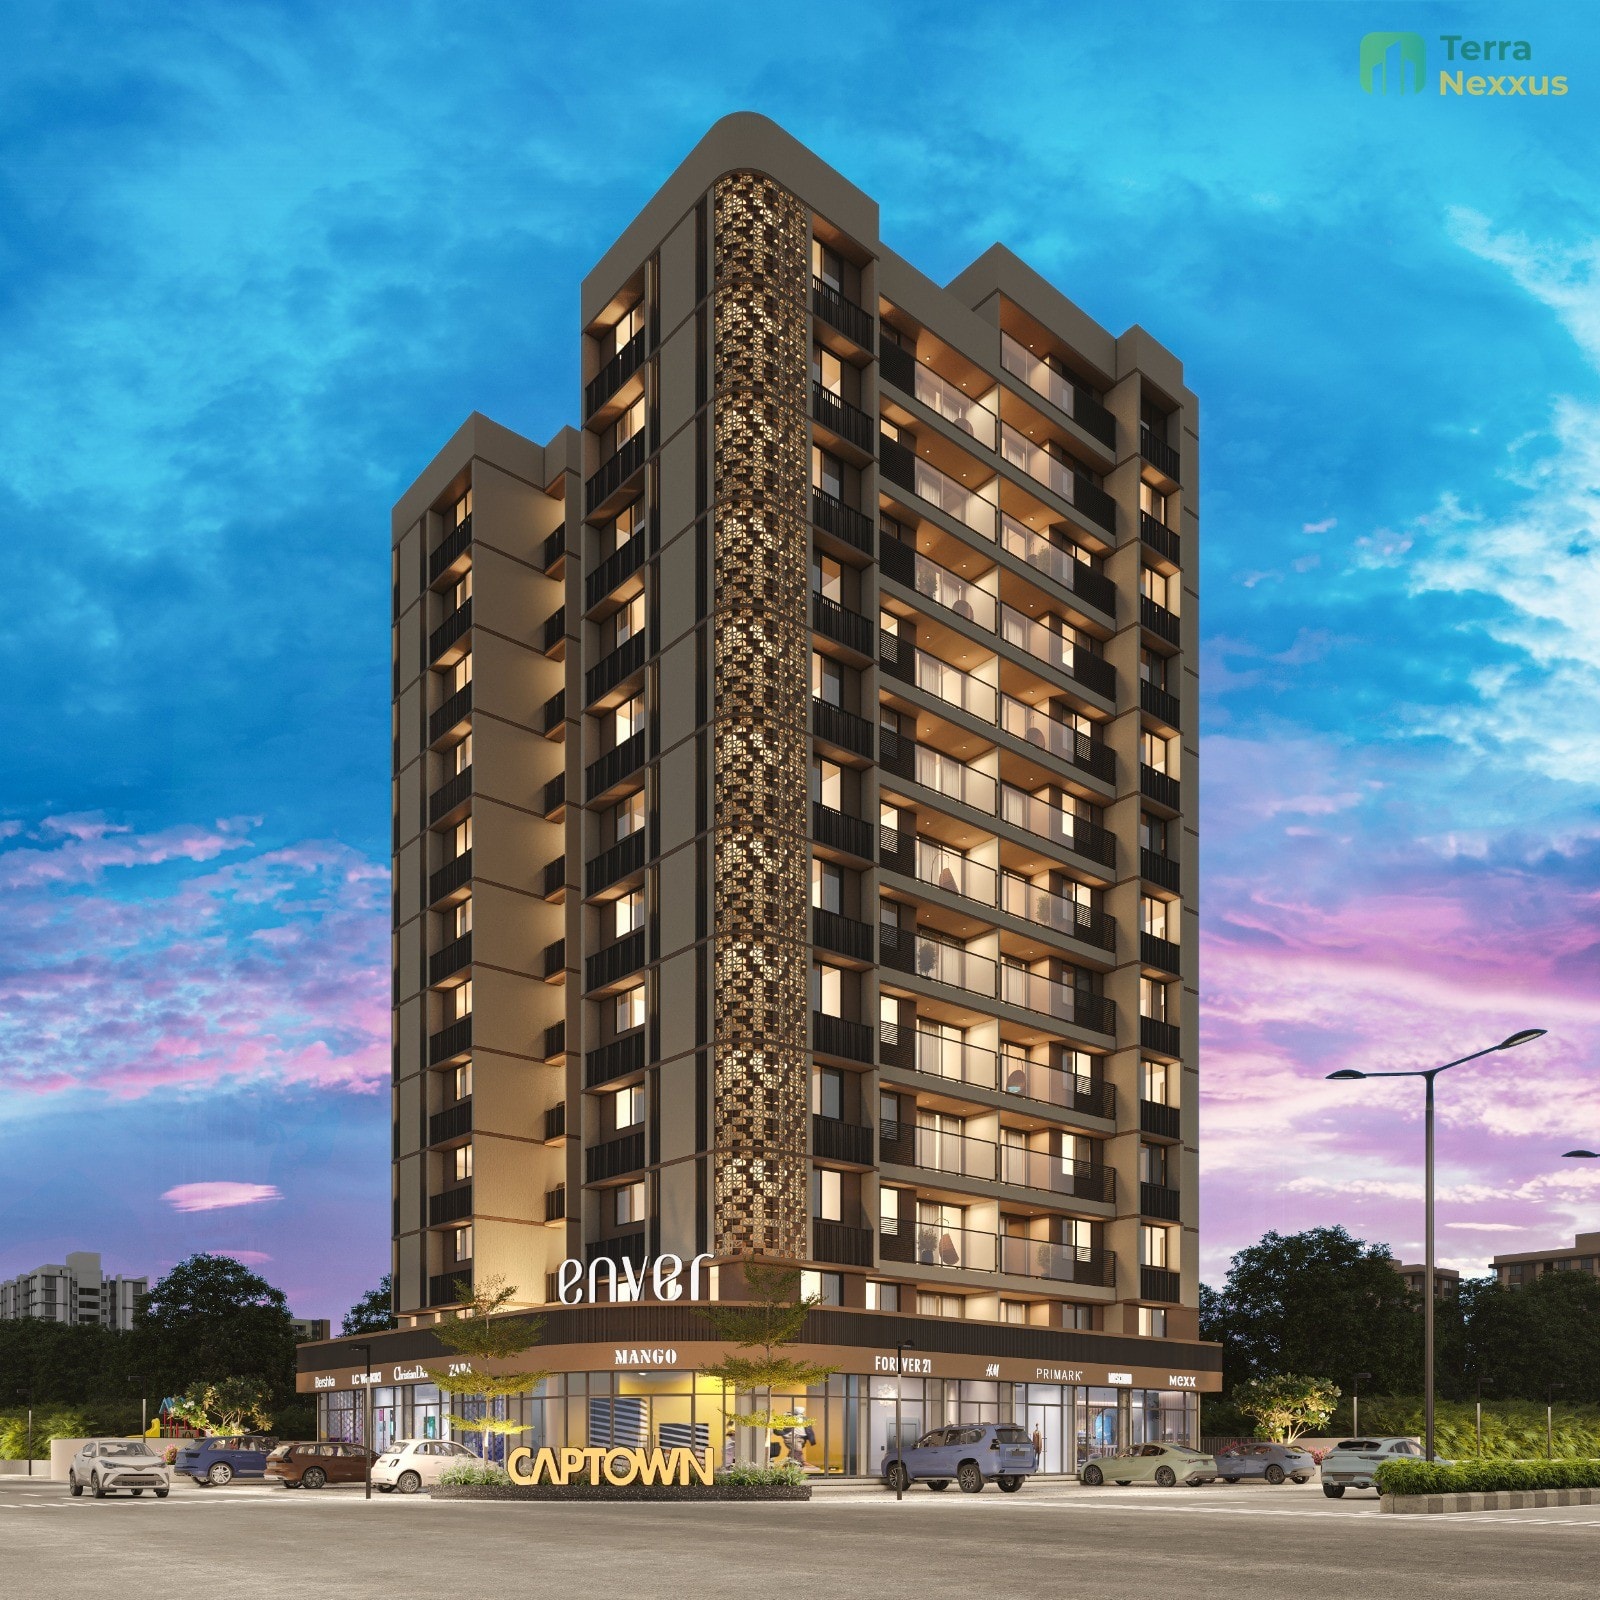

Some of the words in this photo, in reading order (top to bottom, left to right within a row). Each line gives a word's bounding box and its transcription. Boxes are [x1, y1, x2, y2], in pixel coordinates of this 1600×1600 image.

[614, 1349, 677, 1365] MANGO
[922, 1359, 932, 1373] 21
[351, 1374, 360, 1385] LC
[1036, 1368, 1081, 1381] PRIMARK
[315, 1376, 336, 1389] Bershka
[507, 1446, 715, 1486] CAPTOWN
